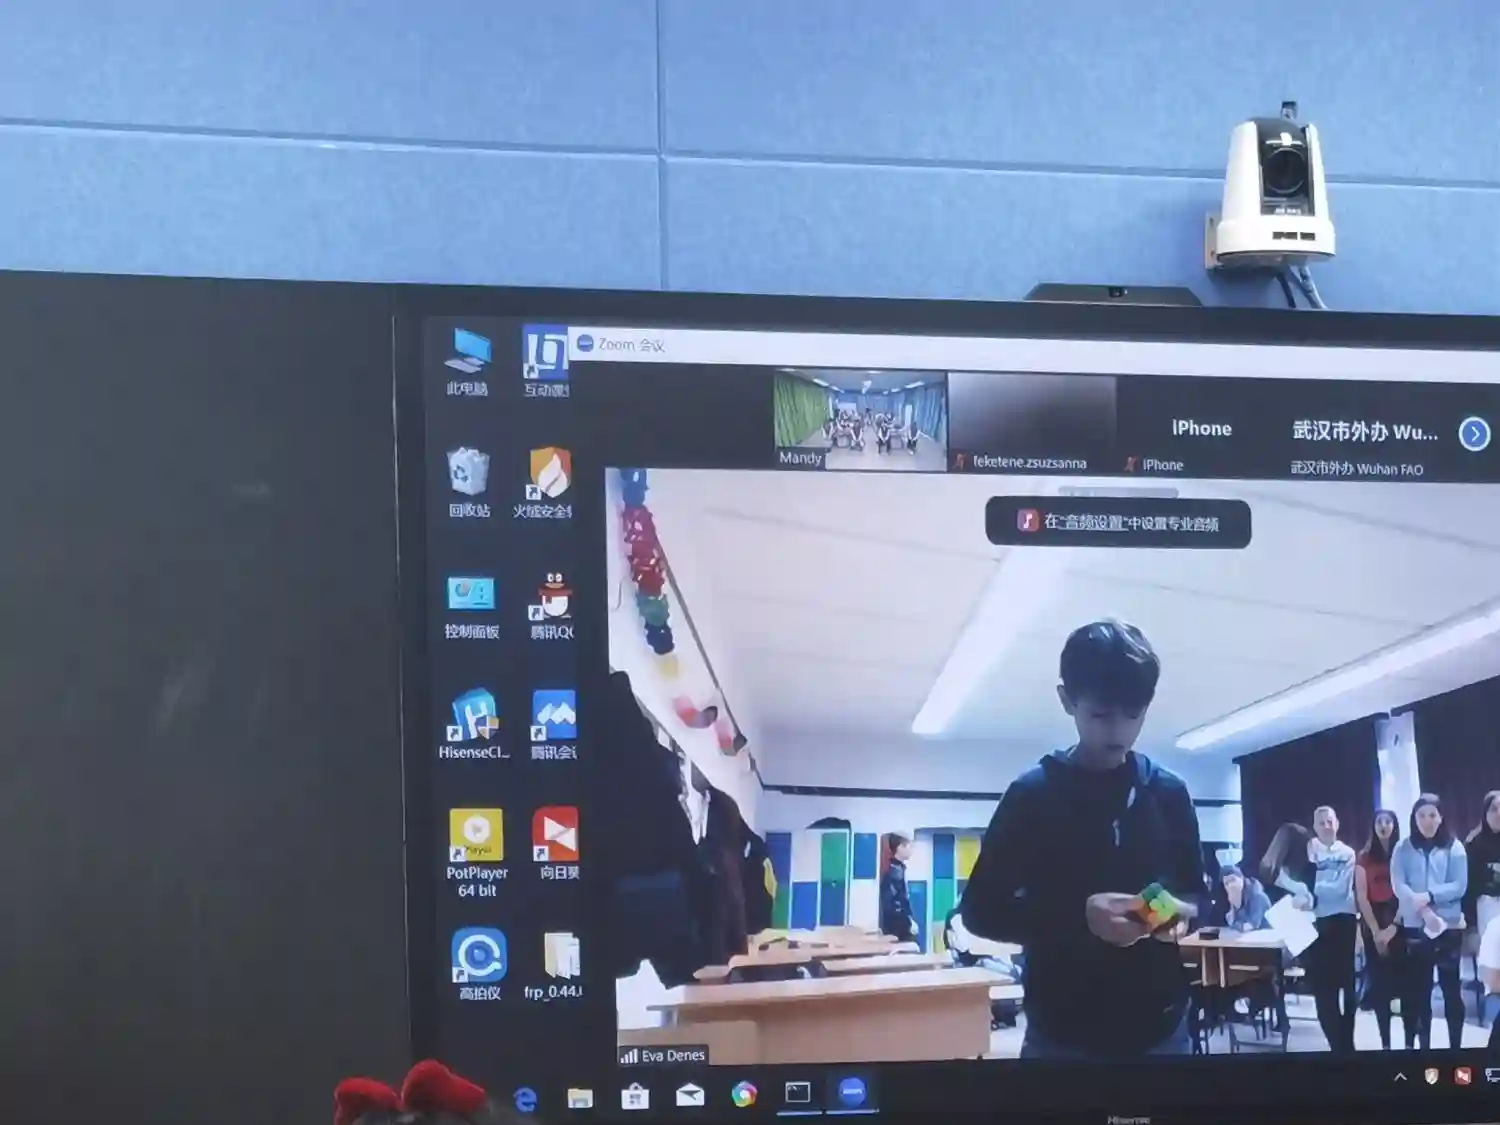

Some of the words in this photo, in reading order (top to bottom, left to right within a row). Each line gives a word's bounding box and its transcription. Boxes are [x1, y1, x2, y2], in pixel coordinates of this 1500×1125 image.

[599, 337, 635, 352] Zoom
[640, 338, 666, 353] 会议
[447, 381, 488, 396] 此电脑
[1172, 419, 1232, 437] iPhone
[1293, 420, 1389, 443] 武汉市外办
[779, 450, 822, 466] Mandy
[1142, 458, 1184, 472] iPhone
[1291, 461, 1354, 477] 武汉市外办
[1357, 463, 1398, 476] Wuhan
[1401, 464, 1423, 477] FAO
[449, 503, 490, 518] 回收站
[445, 623, 500, 640] 控制面板
[447, 866, 508, 880] PotPlayer
[458, 884, 475, 897] 64
[479, 883, 497, 897] bit
[460, 986, 501, 1001] 高拍仪
[641, 1050, 663, 1062] Eva
[667, 1049, 705, 1062] Denes
